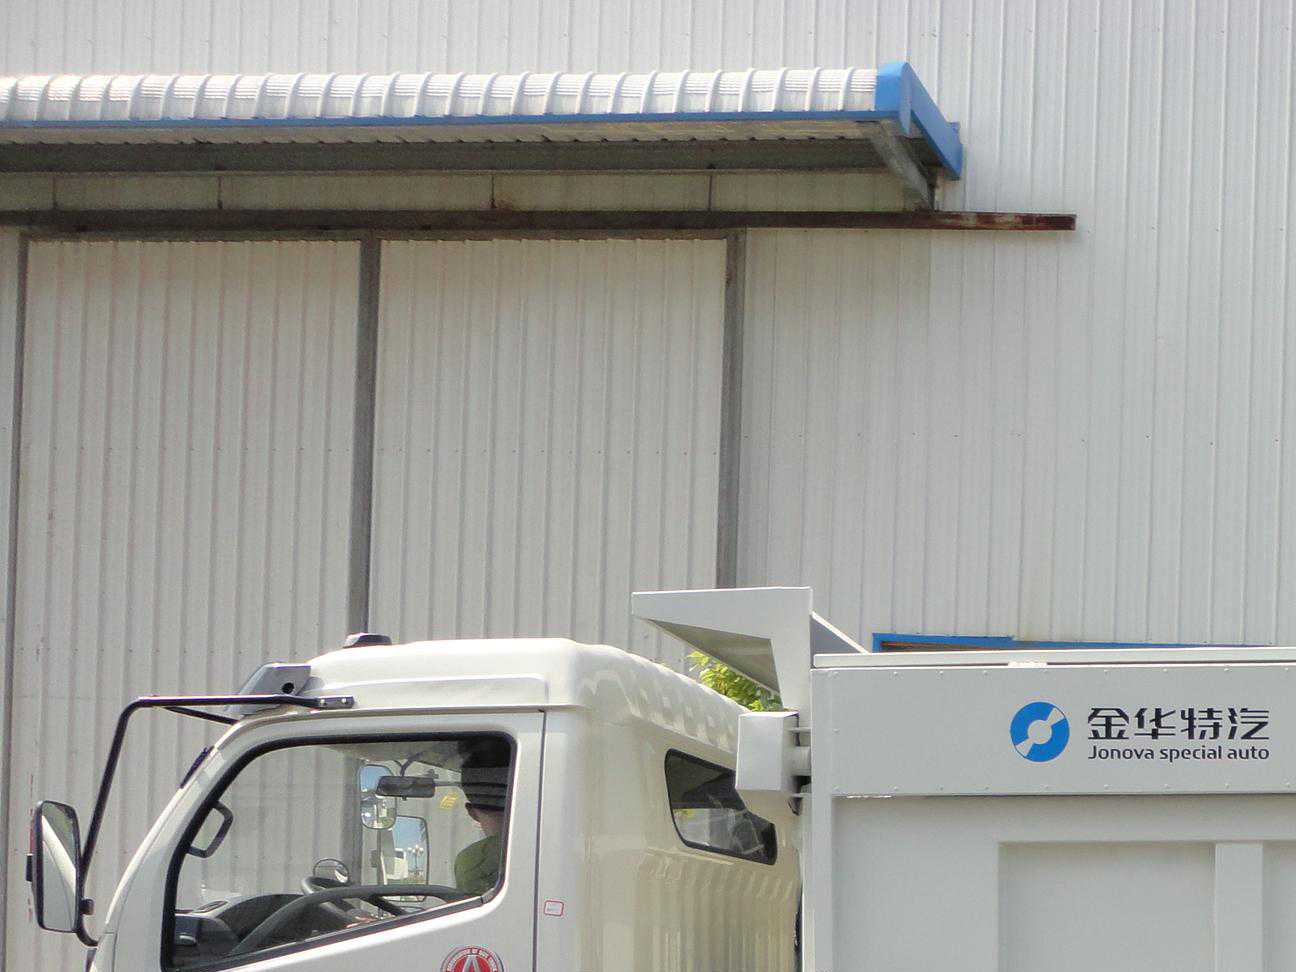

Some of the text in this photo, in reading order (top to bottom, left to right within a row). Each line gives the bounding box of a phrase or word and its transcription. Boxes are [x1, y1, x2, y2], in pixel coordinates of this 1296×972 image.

[1087, 707, 1270, 740] 金华特汽
[1087, 745, 1270, 763] Jonova special auto
